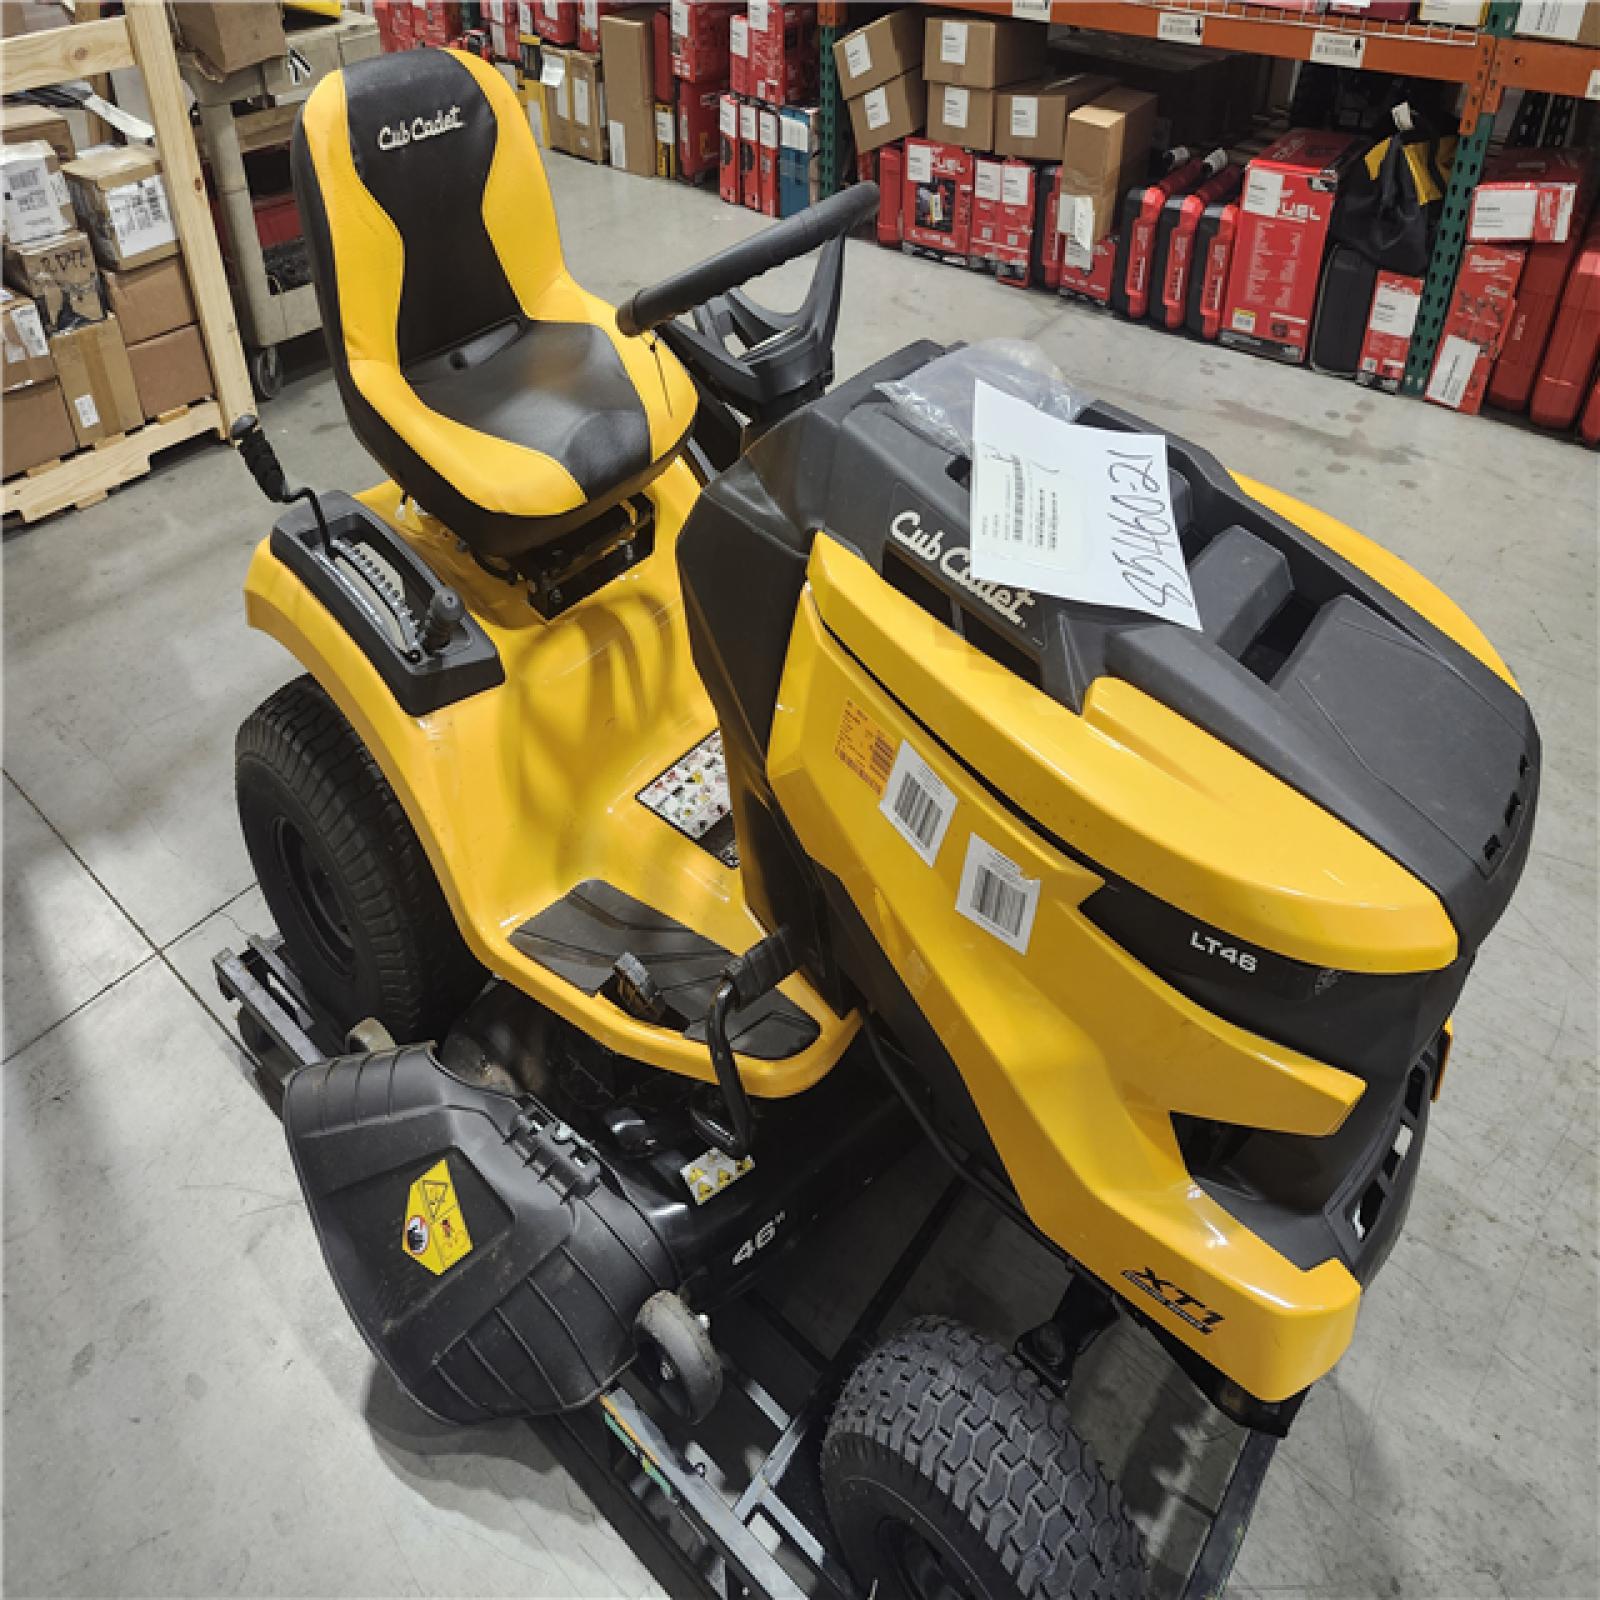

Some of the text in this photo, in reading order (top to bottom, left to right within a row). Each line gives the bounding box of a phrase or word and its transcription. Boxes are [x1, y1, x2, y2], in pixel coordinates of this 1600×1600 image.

[379, 104, 464, 151] Cub Cadet
[889, 509, 946, 561] Cub
[1190, 931, 1257, 972] LT46
